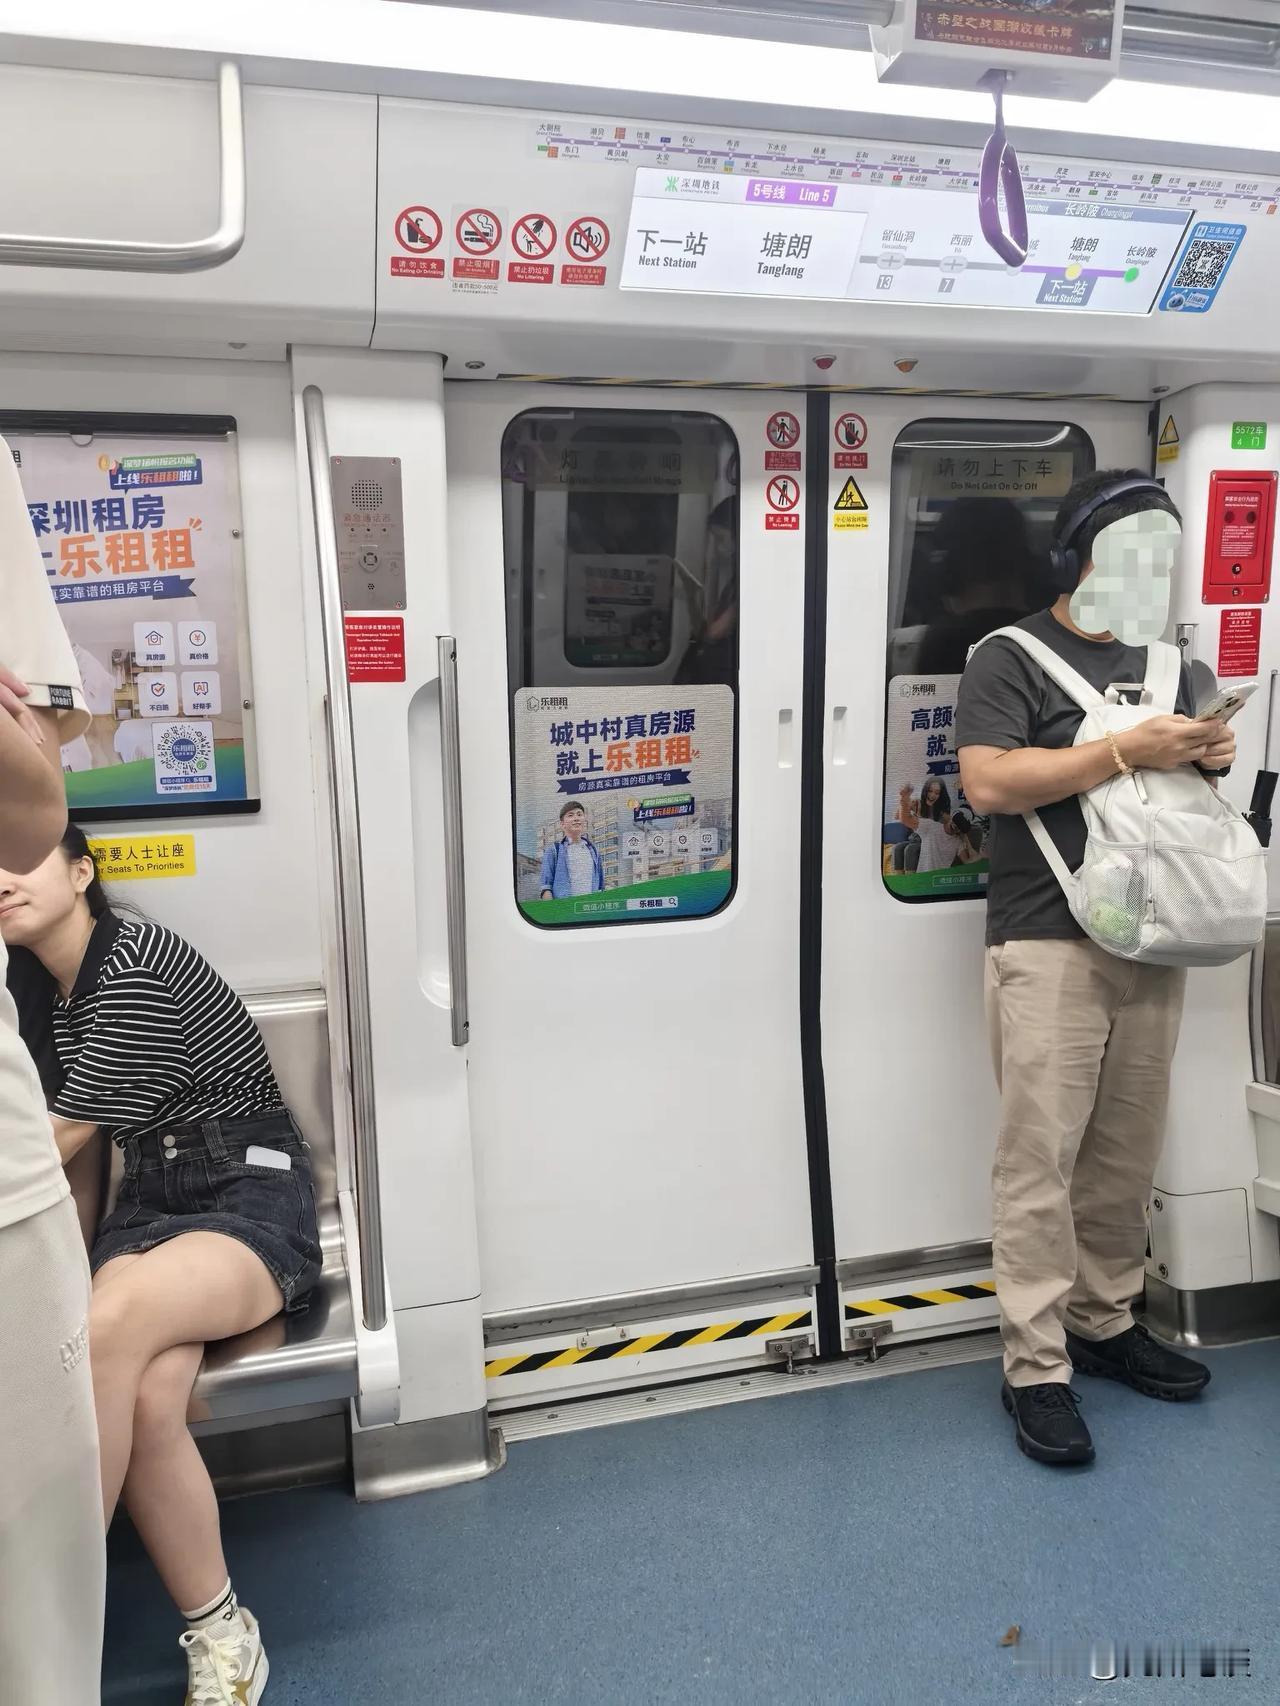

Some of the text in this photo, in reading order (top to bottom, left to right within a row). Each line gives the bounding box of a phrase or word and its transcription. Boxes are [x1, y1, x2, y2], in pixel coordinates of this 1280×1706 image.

[681, 178, 720, 191] 深圳地铁
[753, 184, 830, 203] 5号线 Line 5
[1065, 204, 1101, 218] 长岭陂
[637, 229, 708, 257] 下一站
[882, 229, 916, 243] 留仙洞
[950, 234, 974, 247] 西丽
[760, 232, 813, 260] 塘朗
[1070, 237, 1099, 253] 塘朗
[1127, 246, 1158, 258] 长岭陂
[398, 260, 437, 270] 请勿饮食
[638, 255, 697, 269] Next Station
[757, 261, 805, 279] Tanglang
[878, 275, 891, 289] 13
[1050, 279, 1088, 295] 下一站
[1043, 293, 1082, 304] Next Station
[1235, 425, 1264, 436] 5572车
[1237, 436, 1260, 447] 4 门
[937, 457, 1053, 478] 请勿上下车
[951, 482, 1038, 491] Do Not Get On Or Off
[27, 494, 165, 538] 深圳租房
[42, 528, 196, 579] 乐租租
[146, 653, 166, 661] 真房源
[189, 652, 209, 660] 真价格
[192, 702, 212, 710] 好帮手
[541, 697, 568, 706] 乐租租
[911, 705, 957, 731] 高颜
[550, 708, 695, 746] 城中村真房源
[926, 734, 957, 757] 就
[556, 735, 692, 776] 就上乐租租
[578, 772, 672, 791] 房源真实靠谱的租房平台
[94, 842, 185, 862] 需要人士让座
[107, 865, 132, 874] Seats
[135, 864, 144, 872] To
[147, 861, 185, 870] Priorities
[640, 899, 663, 908] 乐租租
